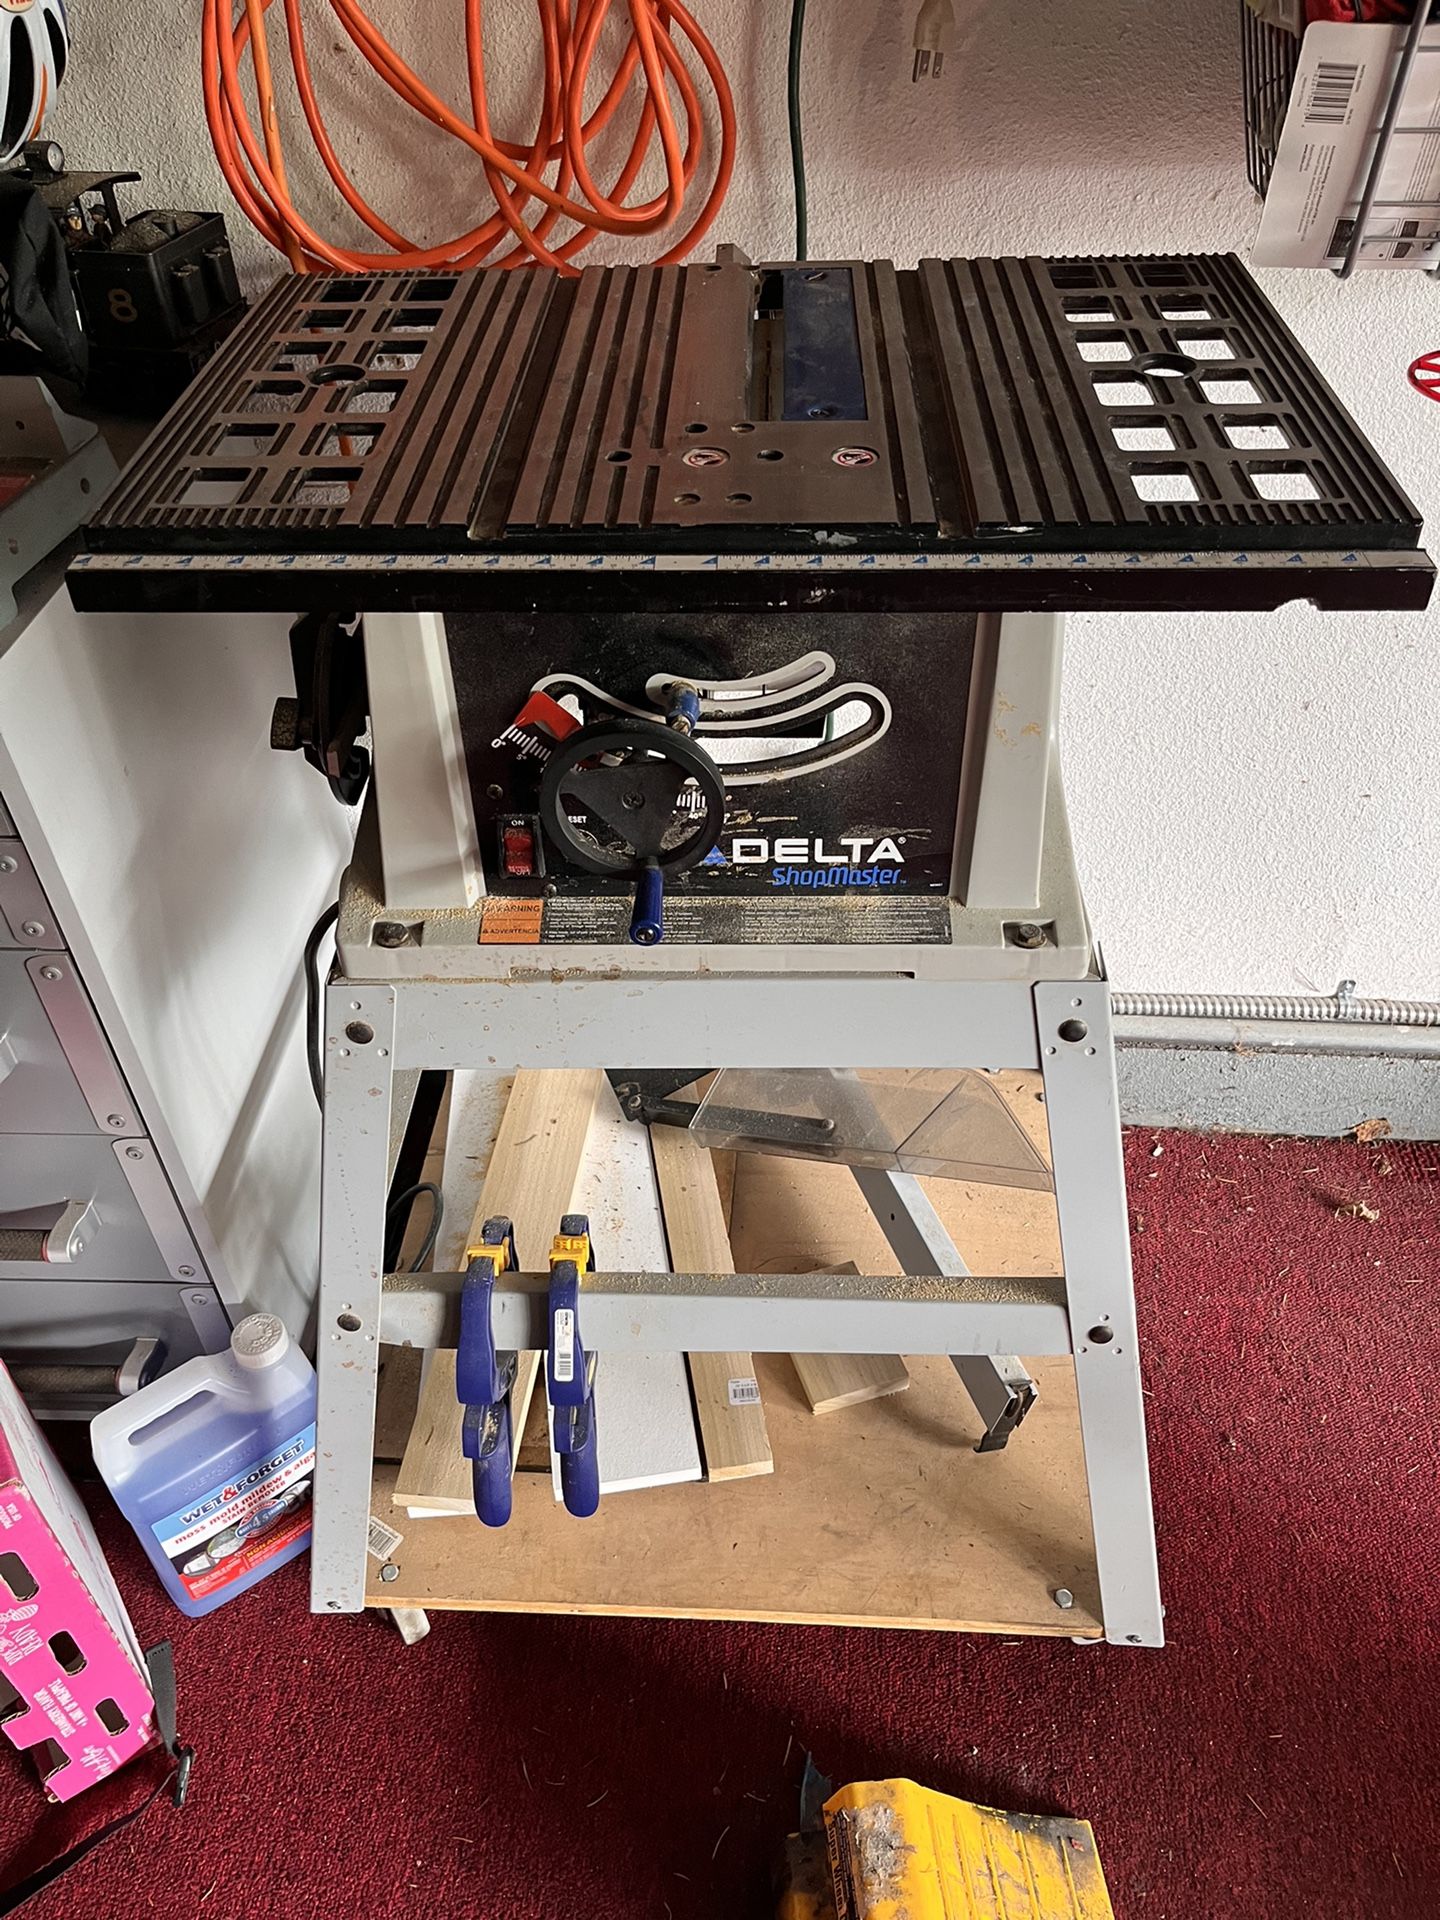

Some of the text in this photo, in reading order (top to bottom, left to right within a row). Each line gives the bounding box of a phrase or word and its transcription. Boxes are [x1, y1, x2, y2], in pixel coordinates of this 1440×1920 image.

[107, 288, 139, 323] 8
[567, 815, 588, 824] ESET
[732, 837, 905, 864] DELTA
[771, 865, 902, 889] ShopMaster
[174, 1525, 207, 1545] moss
[209, 1502, 239, 1525] mold
[242, 1474, 282, 1505] mildew
[294, 1452, 315, 1471] alga
[180, 1440, 305, 1525] WET&FORGET
[222, 1506, 247, 1524] STAIN
[247, 1480, 286, 1509] REMOVER
[9, 1623, 44, 1656] READY
[827, 1821, 838, 1861] Super
